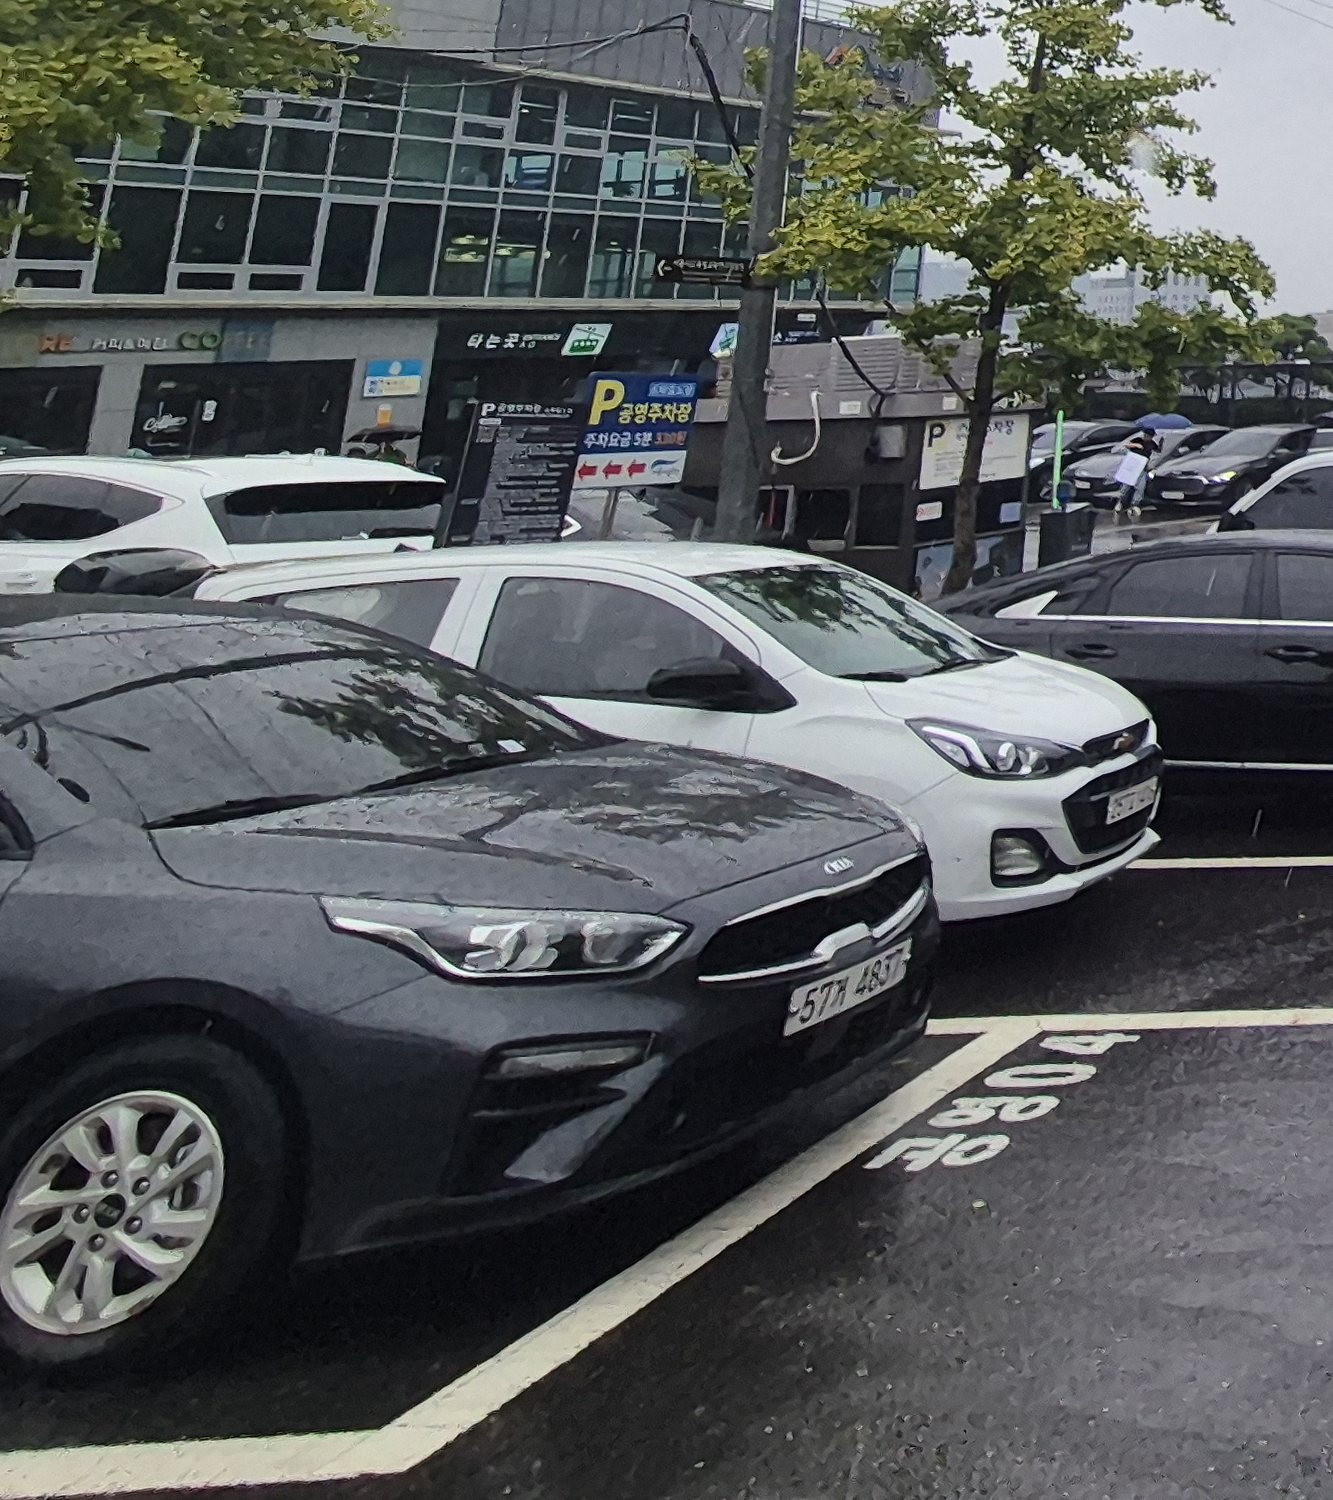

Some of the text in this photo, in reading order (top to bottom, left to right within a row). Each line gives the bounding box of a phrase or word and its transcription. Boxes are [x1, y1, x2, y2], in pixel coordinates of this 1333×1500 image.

[481, 402, 497, 417] P
[588, 379, 625, 426] P
[617, 402, 693, 425] 공영주차장
[928, 422, 946, 448] P
